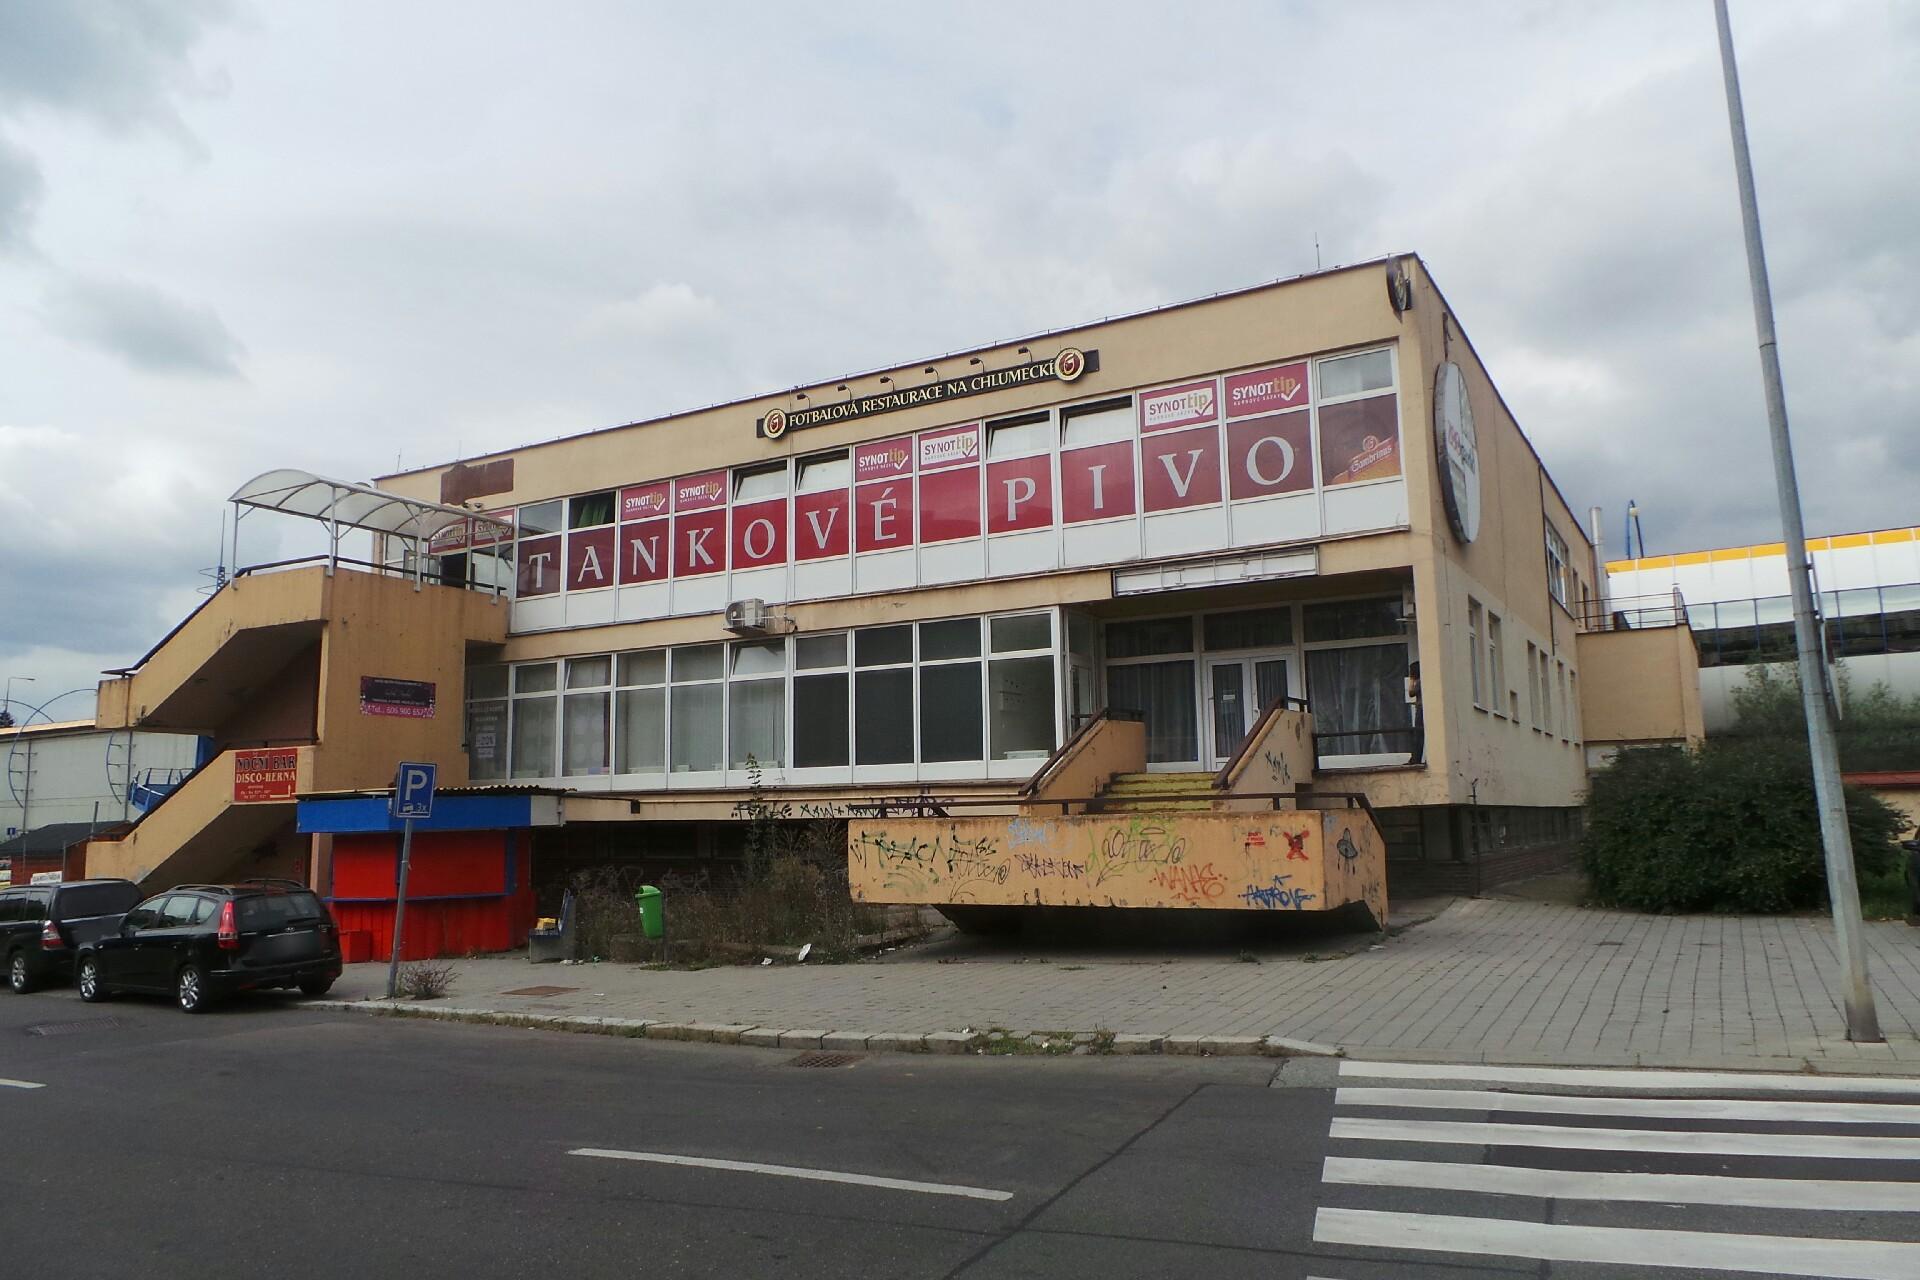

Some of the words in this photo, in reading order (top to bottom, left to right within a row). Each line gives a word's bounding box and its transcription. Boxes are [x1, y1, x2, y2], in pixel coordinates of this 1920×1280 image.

[789, 400, 859, 428] FOTBALOVÁ
[862, 384, 943, 413] RESTAURACE
[947, 382, 968, 395] NA
[1351, 446, 1393, 473] Gambrinus
[273, 754, 296, 770] BAR
[236, 771, 296, 784] DISCO-HERNA
[405, 770, 428, 801] P
